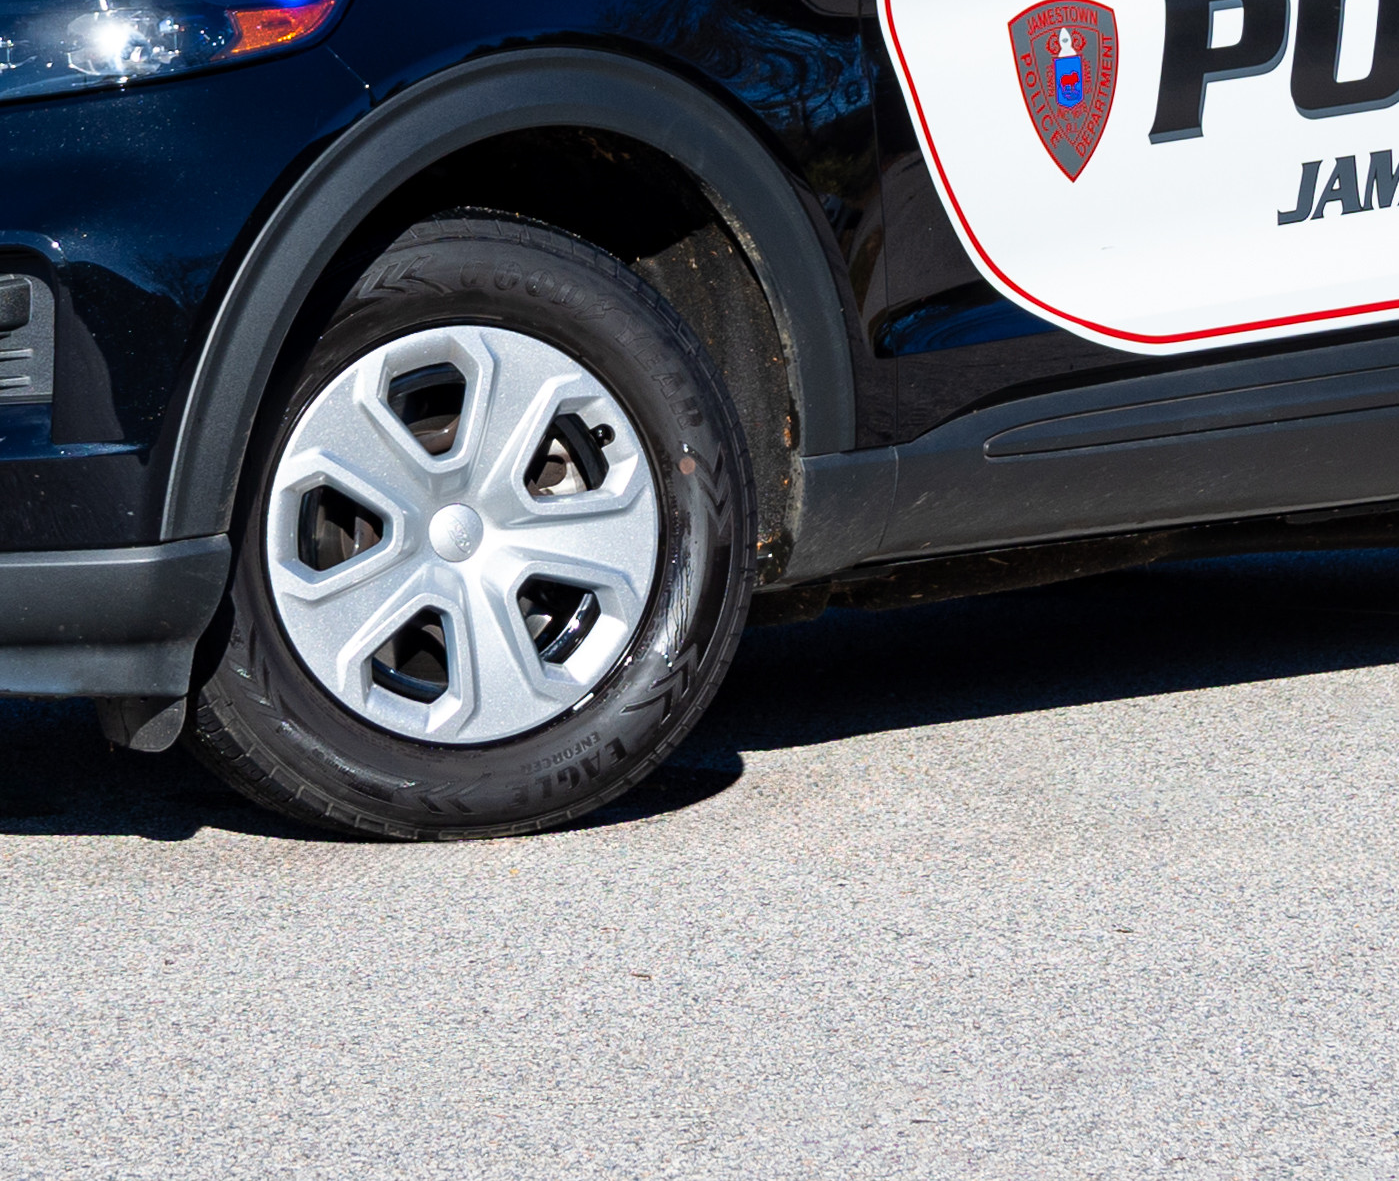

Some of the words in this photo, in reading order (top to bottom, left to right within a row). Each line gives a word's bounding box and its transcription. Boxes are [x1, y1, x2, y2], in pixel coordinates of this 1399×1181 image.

[1026, 5, 1098, 36] JAMESTOWN
[1020, 52, 1064, 150] POLICE
[1075, 32, 1114, 159] DEPARTMENT
[509, 736, 628, 808] EAGLE
